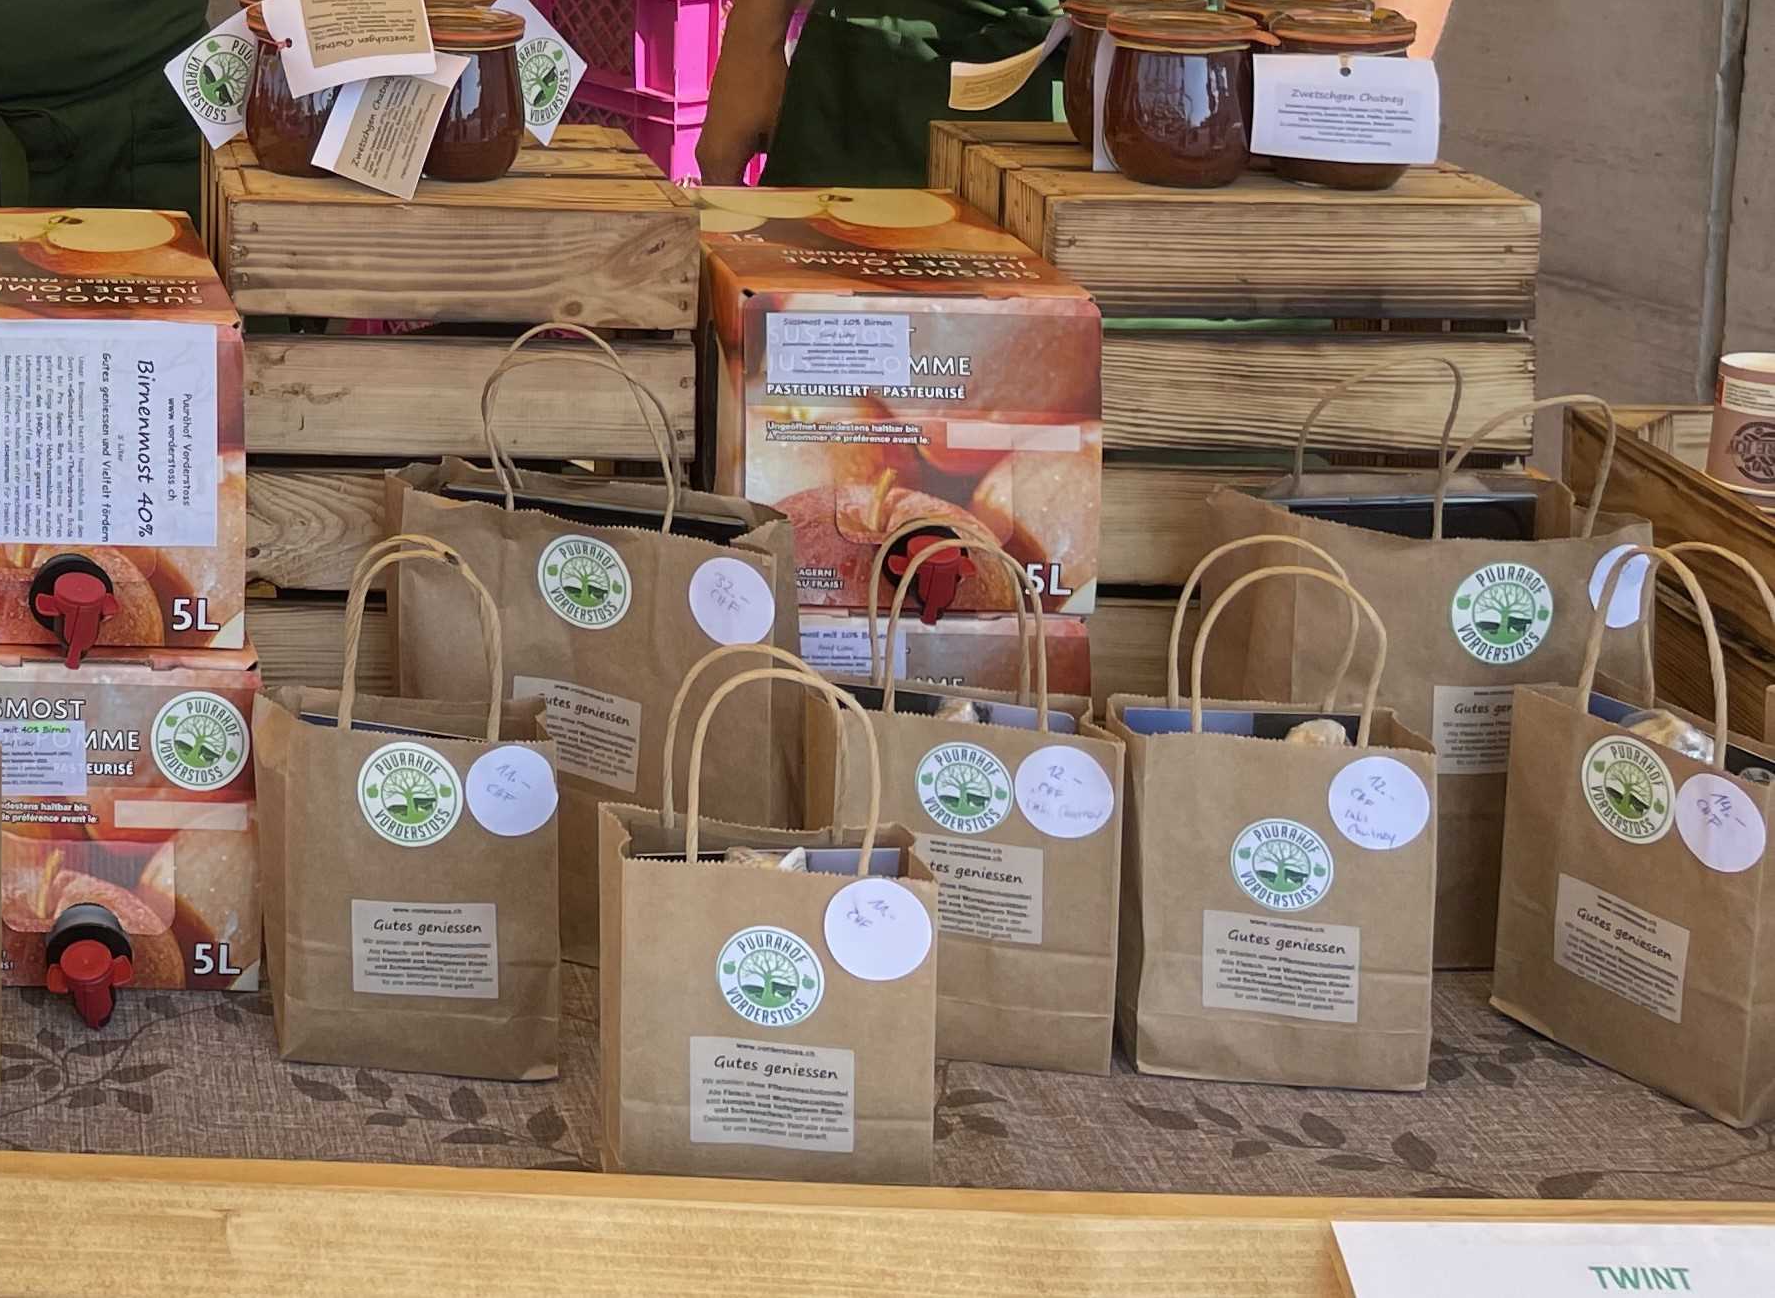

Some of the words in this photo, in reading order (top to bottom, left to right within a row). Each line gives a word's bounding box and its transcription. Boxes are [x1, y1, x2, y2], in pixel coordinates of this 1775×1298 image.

[186, 56, 227, 122] VORDERSTOSS
[102, 353, 111, 382] Gutes
[766, 384, 869, 398] PASTEURISIERT
[883, 385, 966, 400] PASTEURISÉ
[100, 387, 111, 436] geniessen
[137, 360, 156, 483] Birnenmost
[102, 438, 111, 456] und
[182, 444, 192, 507] Vorderstoss
[137, 492, 154, 538] 40%
[1025, 562, 1074, 597] 5L
[172, 599, 220, 632] 5L
[550, 587, 618, 622] VORDERSTOSS
[1457, 621, 1541, 662] VORDERSTOSS
[575, 701, 631, 727] geniessen
[1454, 702, 1489, 716] Gutes
[161, 738, 225, 784] VORDERSTOSS
[374, 808, 450, 839] VORDERSTOSS
[924, 797, 1001, 832] VORDERSTOSS
[1591, 784, 1656, 835] VORDERSTOSS
[954, 865, 1024, 885] geniessen
[1239, 870, 1320, 909] VORDERSTOSS
[374, 919, 413, 933] Gutes
[418, 921, 483, 935] geniessen
[1228, 928, 1270, 947] Gutes
[1275, 936, 1346, 956] geniessen
[1577, 908, 1613, 934] Gutes
[1614, 925, 1673, 962] geniessen
[193, 943, 241, 976] 5L
[725, 986, 809, 1024] VORDERSTOSS
[714, 1055, 759, 1072] Gutes
[763, 1062, 839, 1080] geniessen
[1588, 1266, 1691, 1292] TWINT
